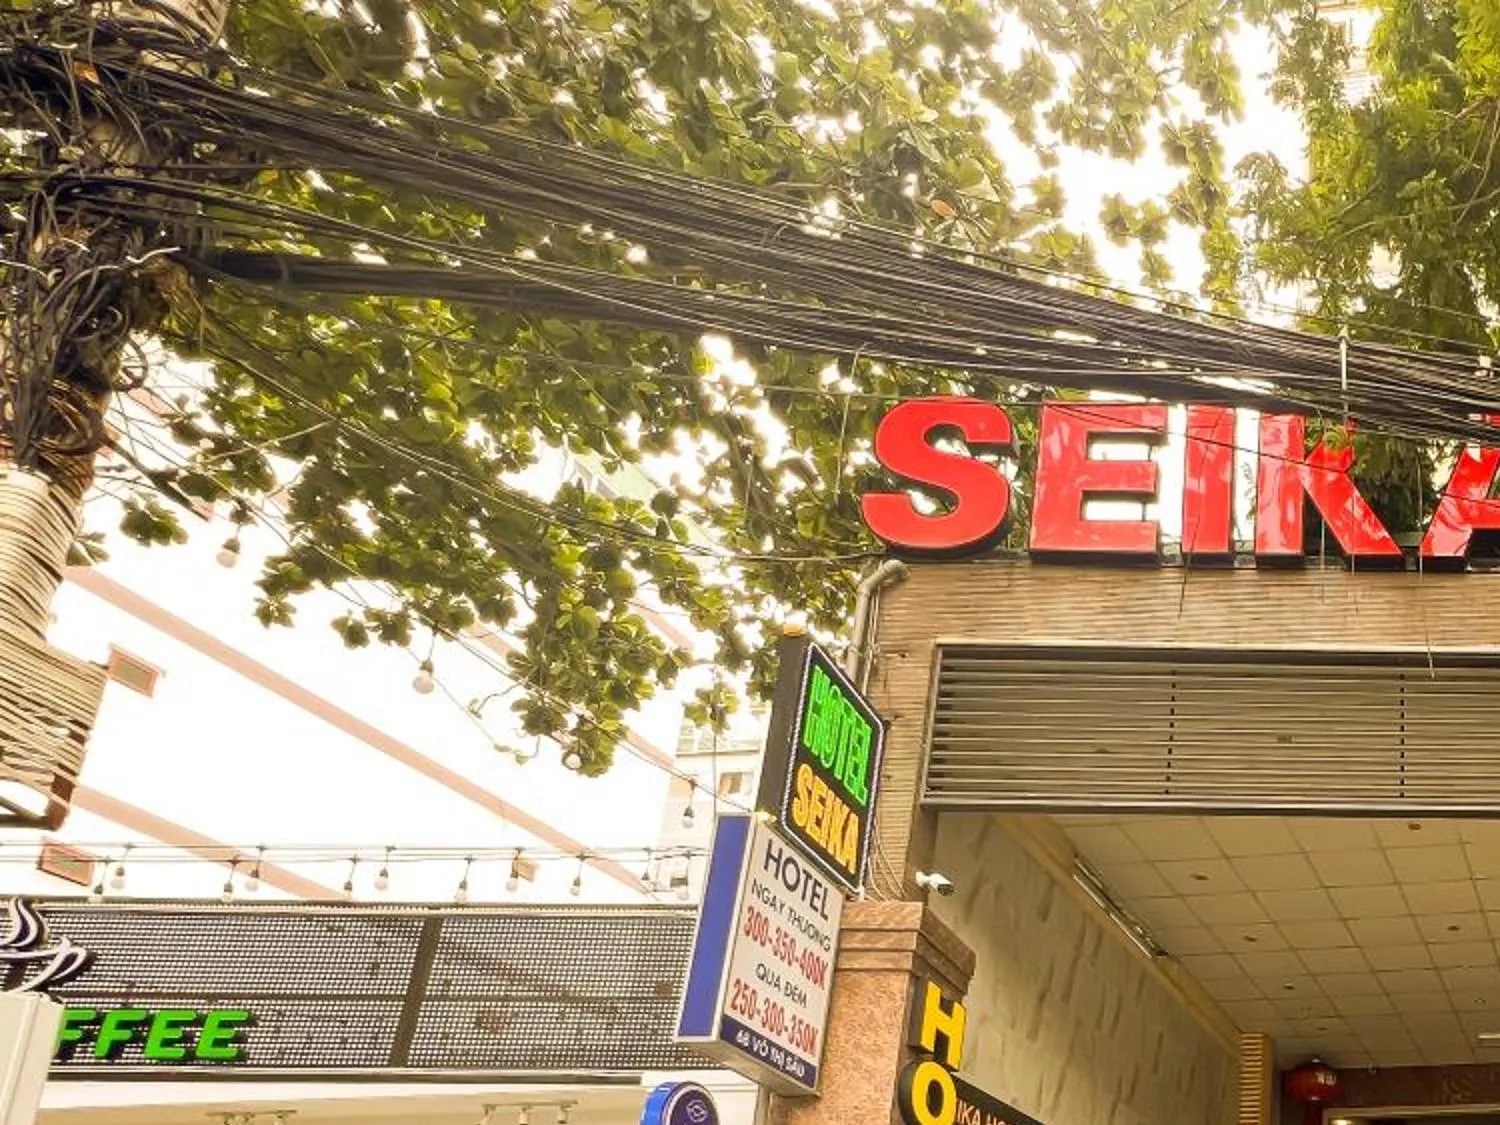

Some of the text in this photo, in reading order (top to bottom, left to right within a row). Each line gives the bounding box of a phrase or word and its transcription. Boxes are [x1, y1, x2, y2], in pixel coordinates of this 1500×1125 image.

[803, 664, 872, 806] HOTEL
[793, 763, 859, 875] SEIKA
[764, 839, 829, 921] HOTEL
[59, 1006, 249, 1059] FFEE
